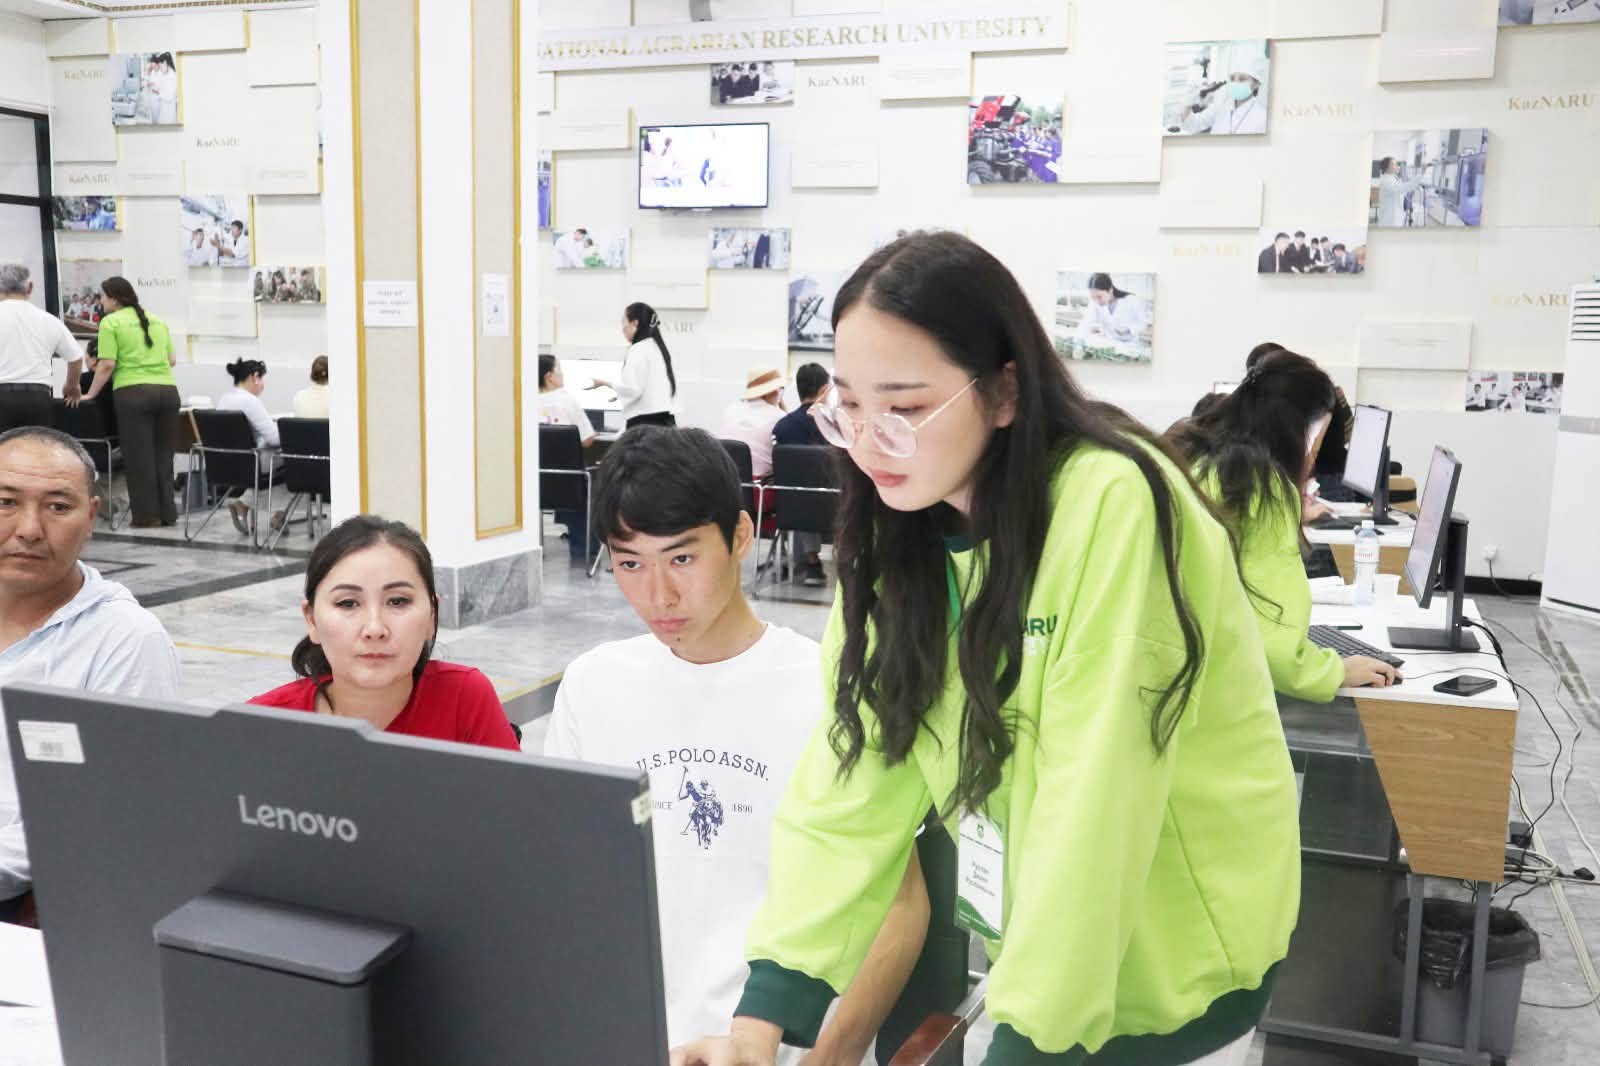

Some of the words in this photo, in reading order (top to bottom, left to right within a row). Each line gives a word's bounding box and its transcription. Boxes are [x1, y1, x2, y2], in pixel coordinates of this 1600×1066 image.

[639, 31, 755, 54] AGRARIAN
[761, 23, 887, 50] RESEARCH
[896, 15, 1055, 43] UNIVERSITY
[1508, 94, 1594, 110] KazNARU
[668, 748, 716, 764] POLO
[718, 751, 769, 782] ASSN.
[238, 795, 358, 843] Lenovo
[733, 803, 752, 813] 1890
